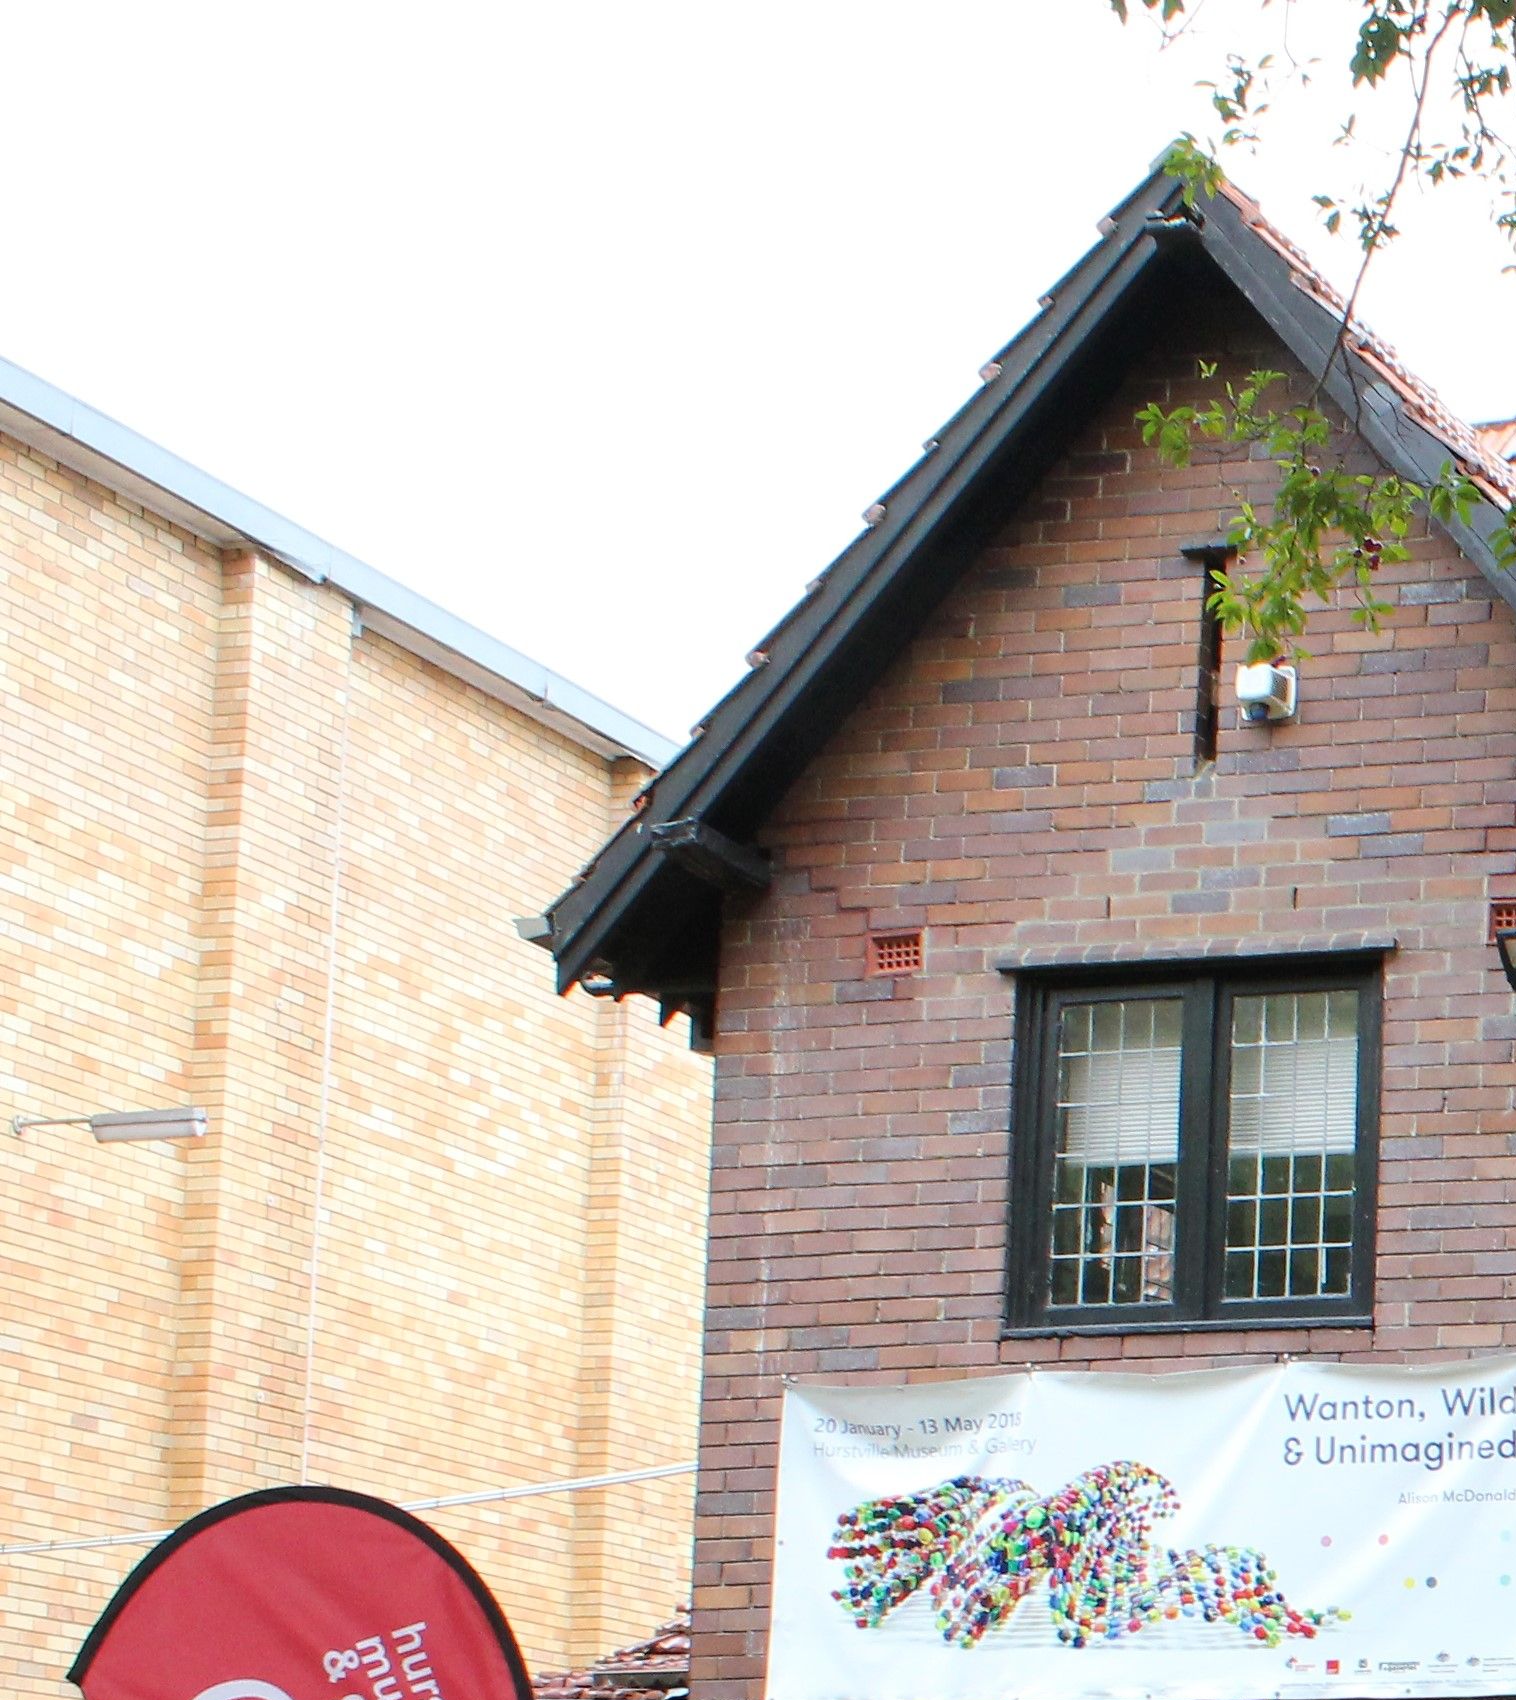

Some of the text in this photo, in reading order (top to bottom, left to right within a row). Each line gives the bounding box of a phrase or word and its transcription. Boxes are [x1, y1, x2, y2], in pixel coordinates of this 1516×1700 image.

[1284, 1393, 1425, 1422] Wanton,
[815, 1418, 837, 1434] 20
[841, 1419, 901, 1440] January
[920, 1419, 939, 1434] 13
[945, 1417, 983, 1434] May
[892, 1444, 962, 1459] Museum
[969, 1439, 979, 1454] &
[1284, 1437, 1303, 1465] &
[1399, 1489, 1516, 1504] Alison McDonald
[323, 1649, 360, 1683] &
